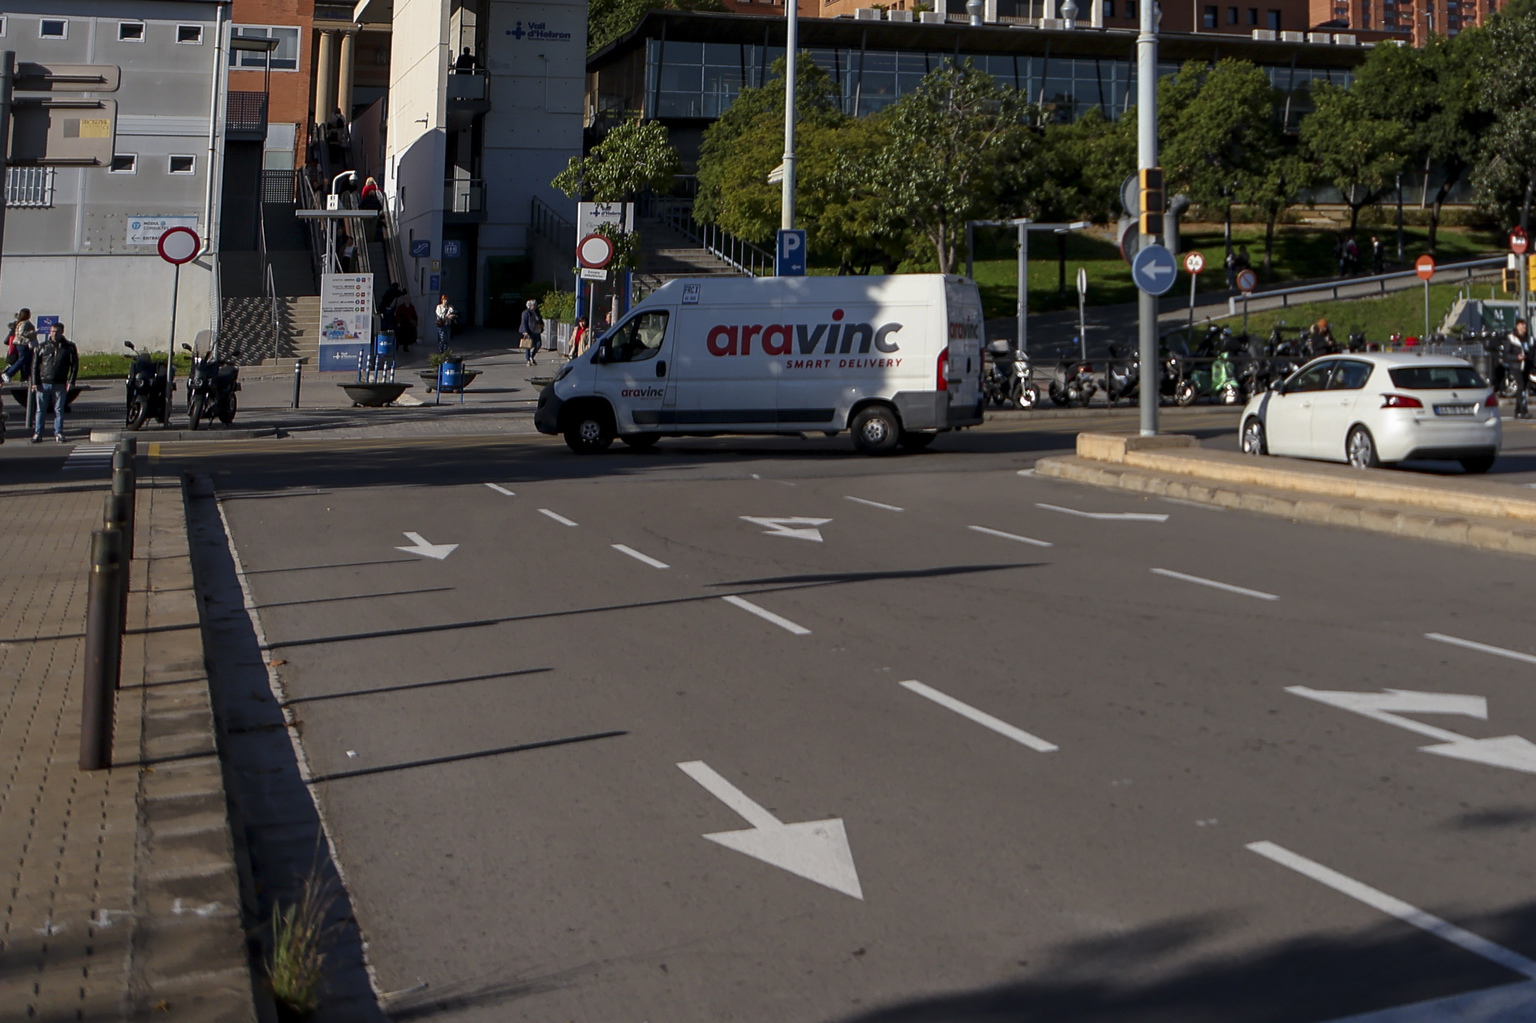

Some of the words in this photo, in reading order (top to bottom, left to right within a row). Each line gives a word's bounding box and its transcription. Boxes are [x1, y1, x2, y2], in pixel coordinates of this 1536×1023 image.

[527, 21, 546, 30] Vall
[527, 30, 571, 39] d'Hebron
[783, 233, 800, 258] P
[706, 308, 903, 356] aravinc
[786, 359, 831, 369] SMART
[839, 358, 904, 368] DELIVERY
[621, 386, 664, 397] aravinc
